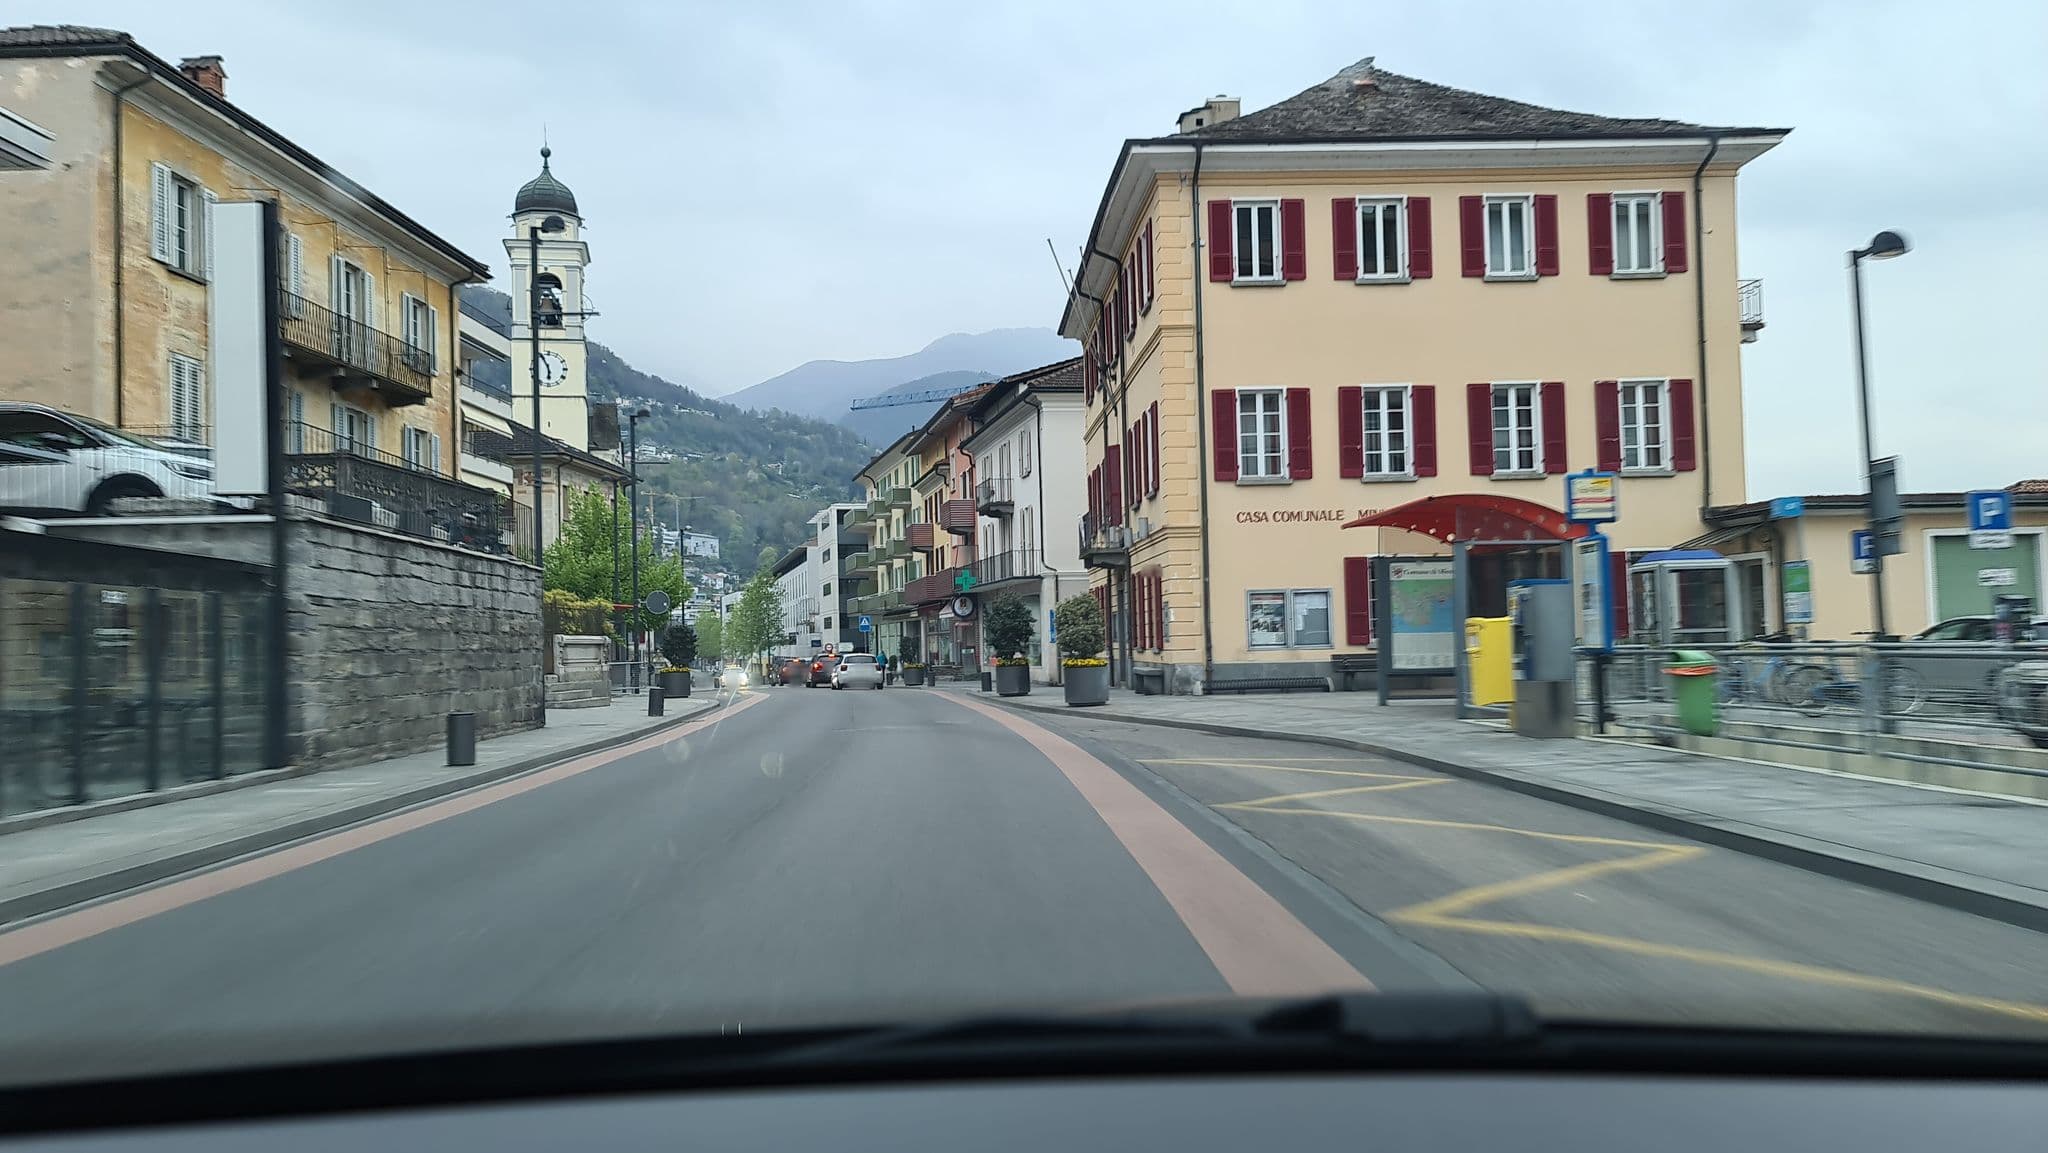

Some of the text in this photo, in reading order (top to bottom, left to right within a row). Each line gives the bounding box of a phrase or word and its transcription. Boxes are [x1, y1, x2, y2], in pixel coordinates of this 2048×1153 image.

[1236, 511, 1269, 524] CASA
[1272, 509, 1345, 523] COMUNALE
[1979, 497, 2005, 527] P
